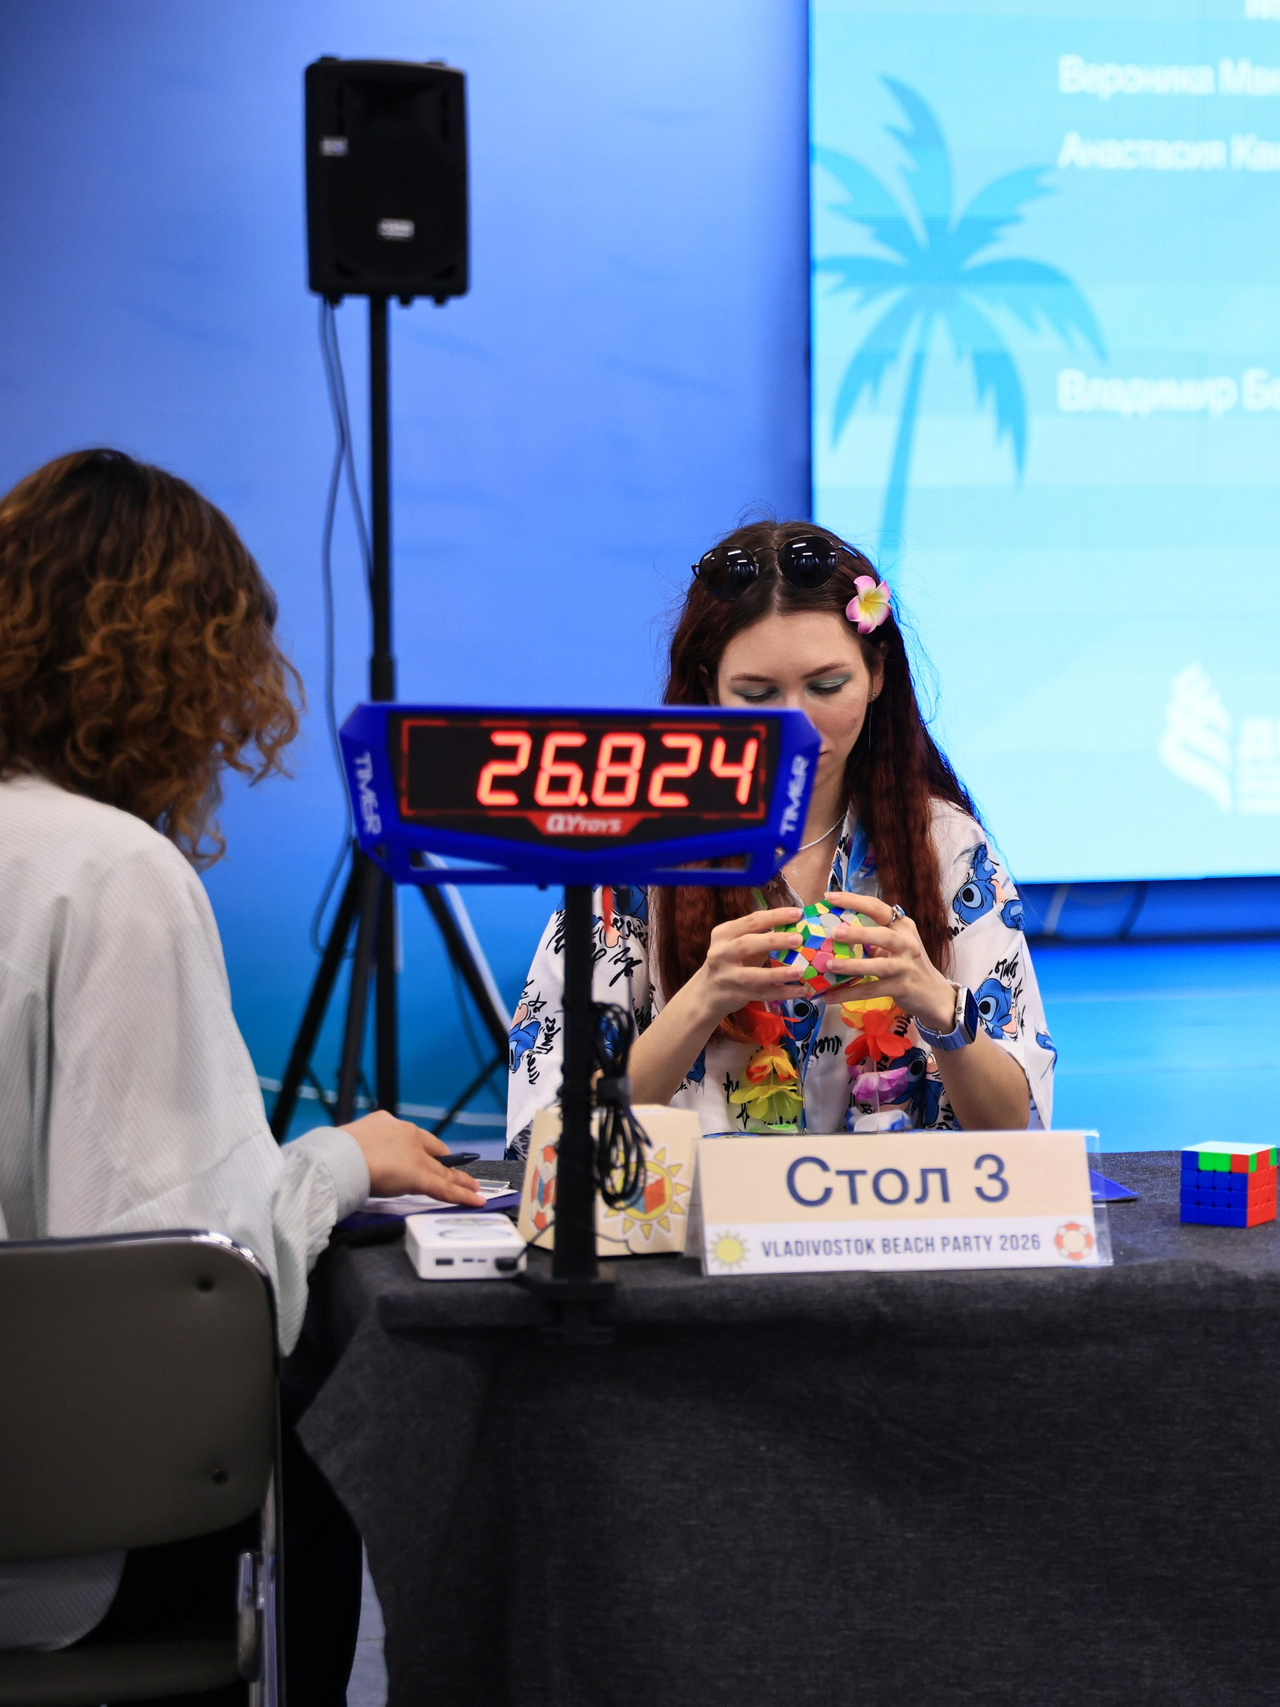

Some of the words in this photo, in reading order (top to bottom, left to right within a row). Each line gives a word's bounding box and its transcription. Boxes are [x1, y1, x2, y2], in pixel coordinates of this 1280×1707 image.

[1058, 54, 1215, 99] Вероника
[1058, 131, 1227, 170] Анастасия
[1057, 369, 1239, 418] Владимир
[354, 751, 382, 834] TIMER
[476, 730, 759, 807] 26.824
[779, 755, 809, 836] TIMER
[786, 1156, 951, 1207] Стол
[973, 1153, 1010, 1203] 3
[761, 1239, 877, 1258] VLADIVOSTOK
[881, 1237, 935, 1255] BEACH
[941, 1235, 993, 1252] PARTY
[999, 1234, 1041, 1251] 2026
